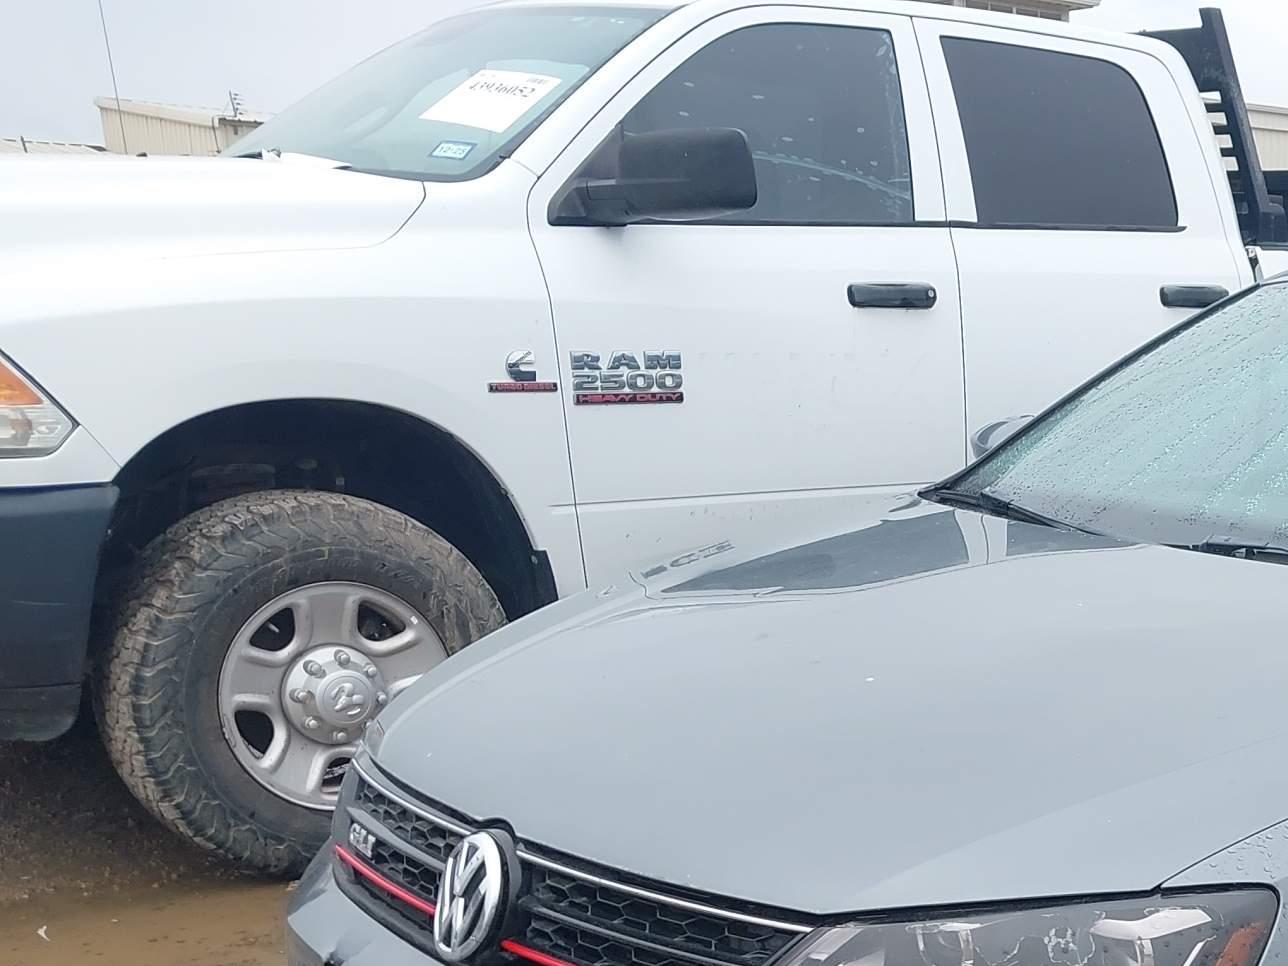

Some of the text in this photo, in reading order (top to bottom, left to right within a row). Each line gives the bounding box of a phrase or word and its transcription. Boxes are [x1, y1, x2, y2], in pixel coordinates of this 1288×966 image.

[569, 350, 682, 370] RAM
[572, 370, 683, 391] 2500
[578, 392, 681, 403] HEAVY DUTY
